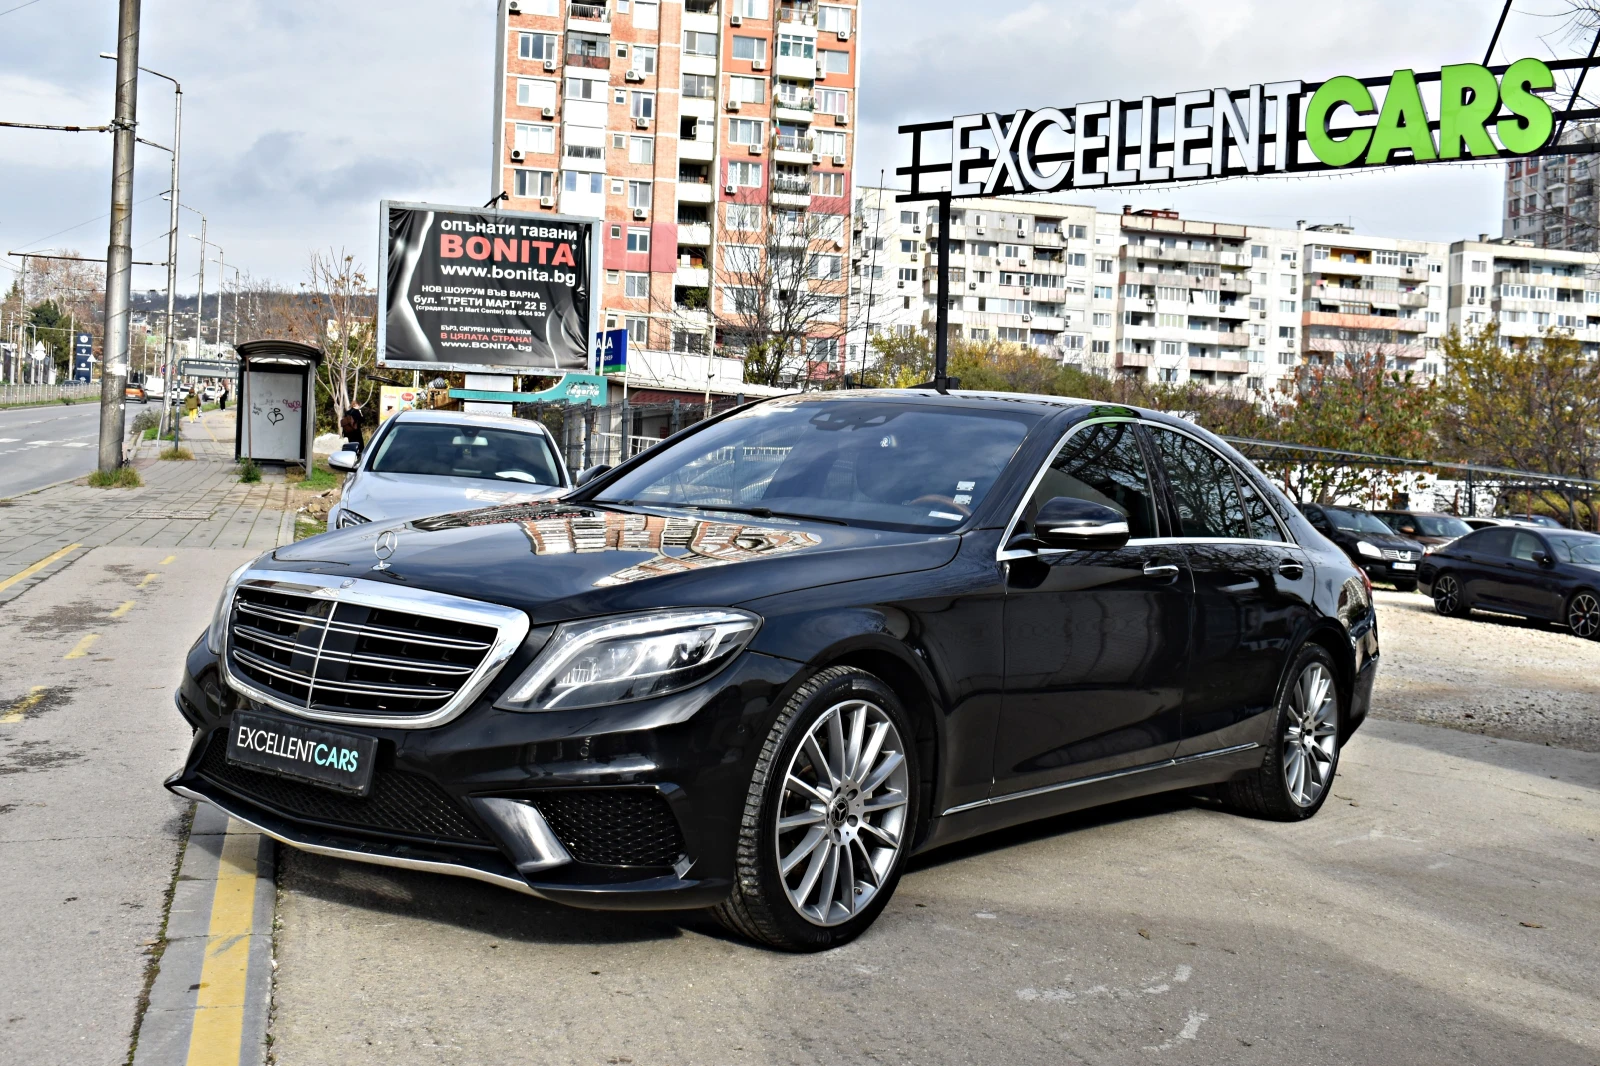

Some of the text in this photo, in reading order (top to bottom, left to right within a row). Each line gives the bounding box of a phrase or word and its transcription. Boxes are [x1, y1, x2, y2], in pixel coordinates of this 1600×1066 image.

[441, 220, 577, 240] опънати тавани
[440, 233, 576, 267] BONITA
[440, 264, 576, 287] www.bonita.bg
[421, 285, 541, 299] НОВ ШОУРУМ ВЪВ ВАРНА
[413, 295, 437, 305] бул.
[524, 302, 537, 310] 22
[539, 302, 547, 311] Б
[459, 325, 486, 333] СИГУРЕН
[449, 333, 490, 341] ЦЯЛАТА
[491, 335, 532, 343] СТРАНА!
[441, 342, 532, 351] www.BONITA.bg
